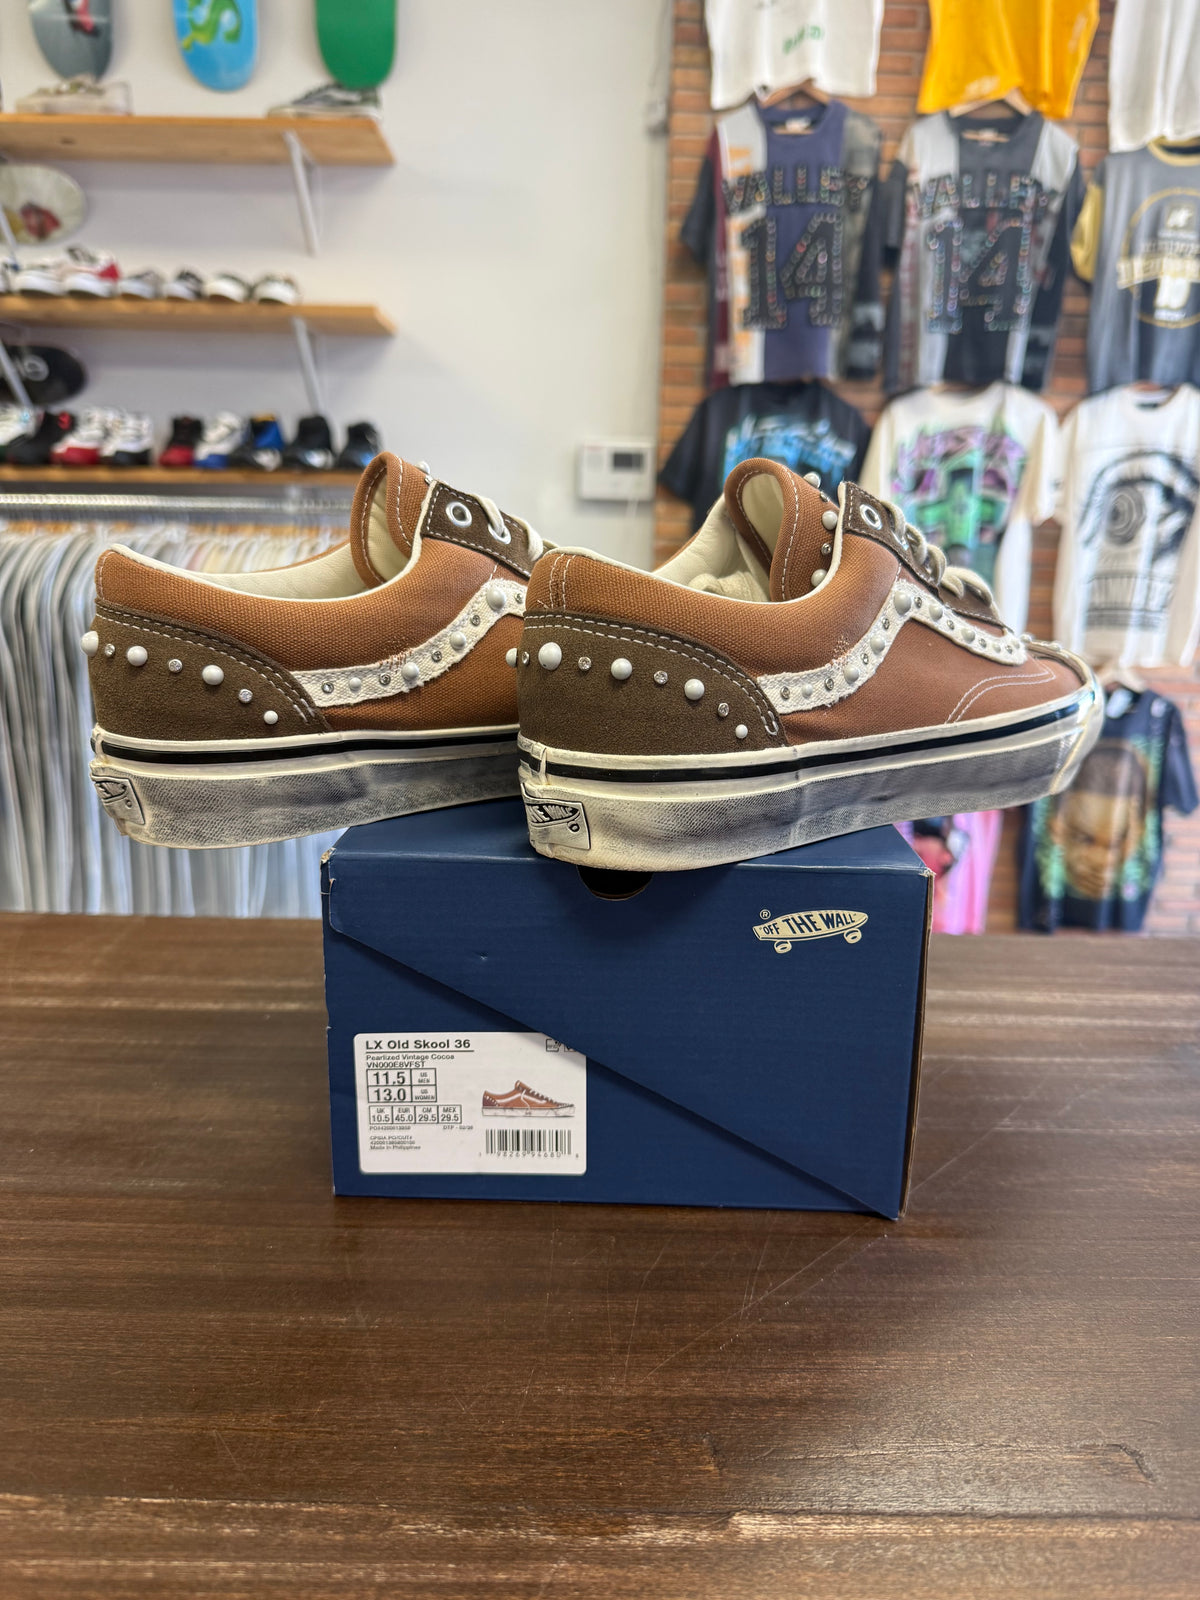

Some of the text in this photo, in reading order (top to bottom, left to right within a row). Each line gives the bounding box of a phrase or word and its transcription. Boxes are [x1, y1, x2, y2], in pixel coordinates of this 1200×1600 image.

[741, 213, 843, 329] 14
[927, 217, 1036, 334] 14
[782, 914, 822, 934] THE
[366, 1039, 471, 1050] LX Old Skool 36
[401, 1053, 430, 1061] Vintage
[373, 1071, 406, 1085] 11.5
[374, 1088, 407, 1101] 13.0
[371, 1114, 391, 1122] 10.5
[395, 1114, 414, 1122] 45.0
[418, 1114, 437, 1122] 29.5
[440, 1114, 459, 1122] 29.5
